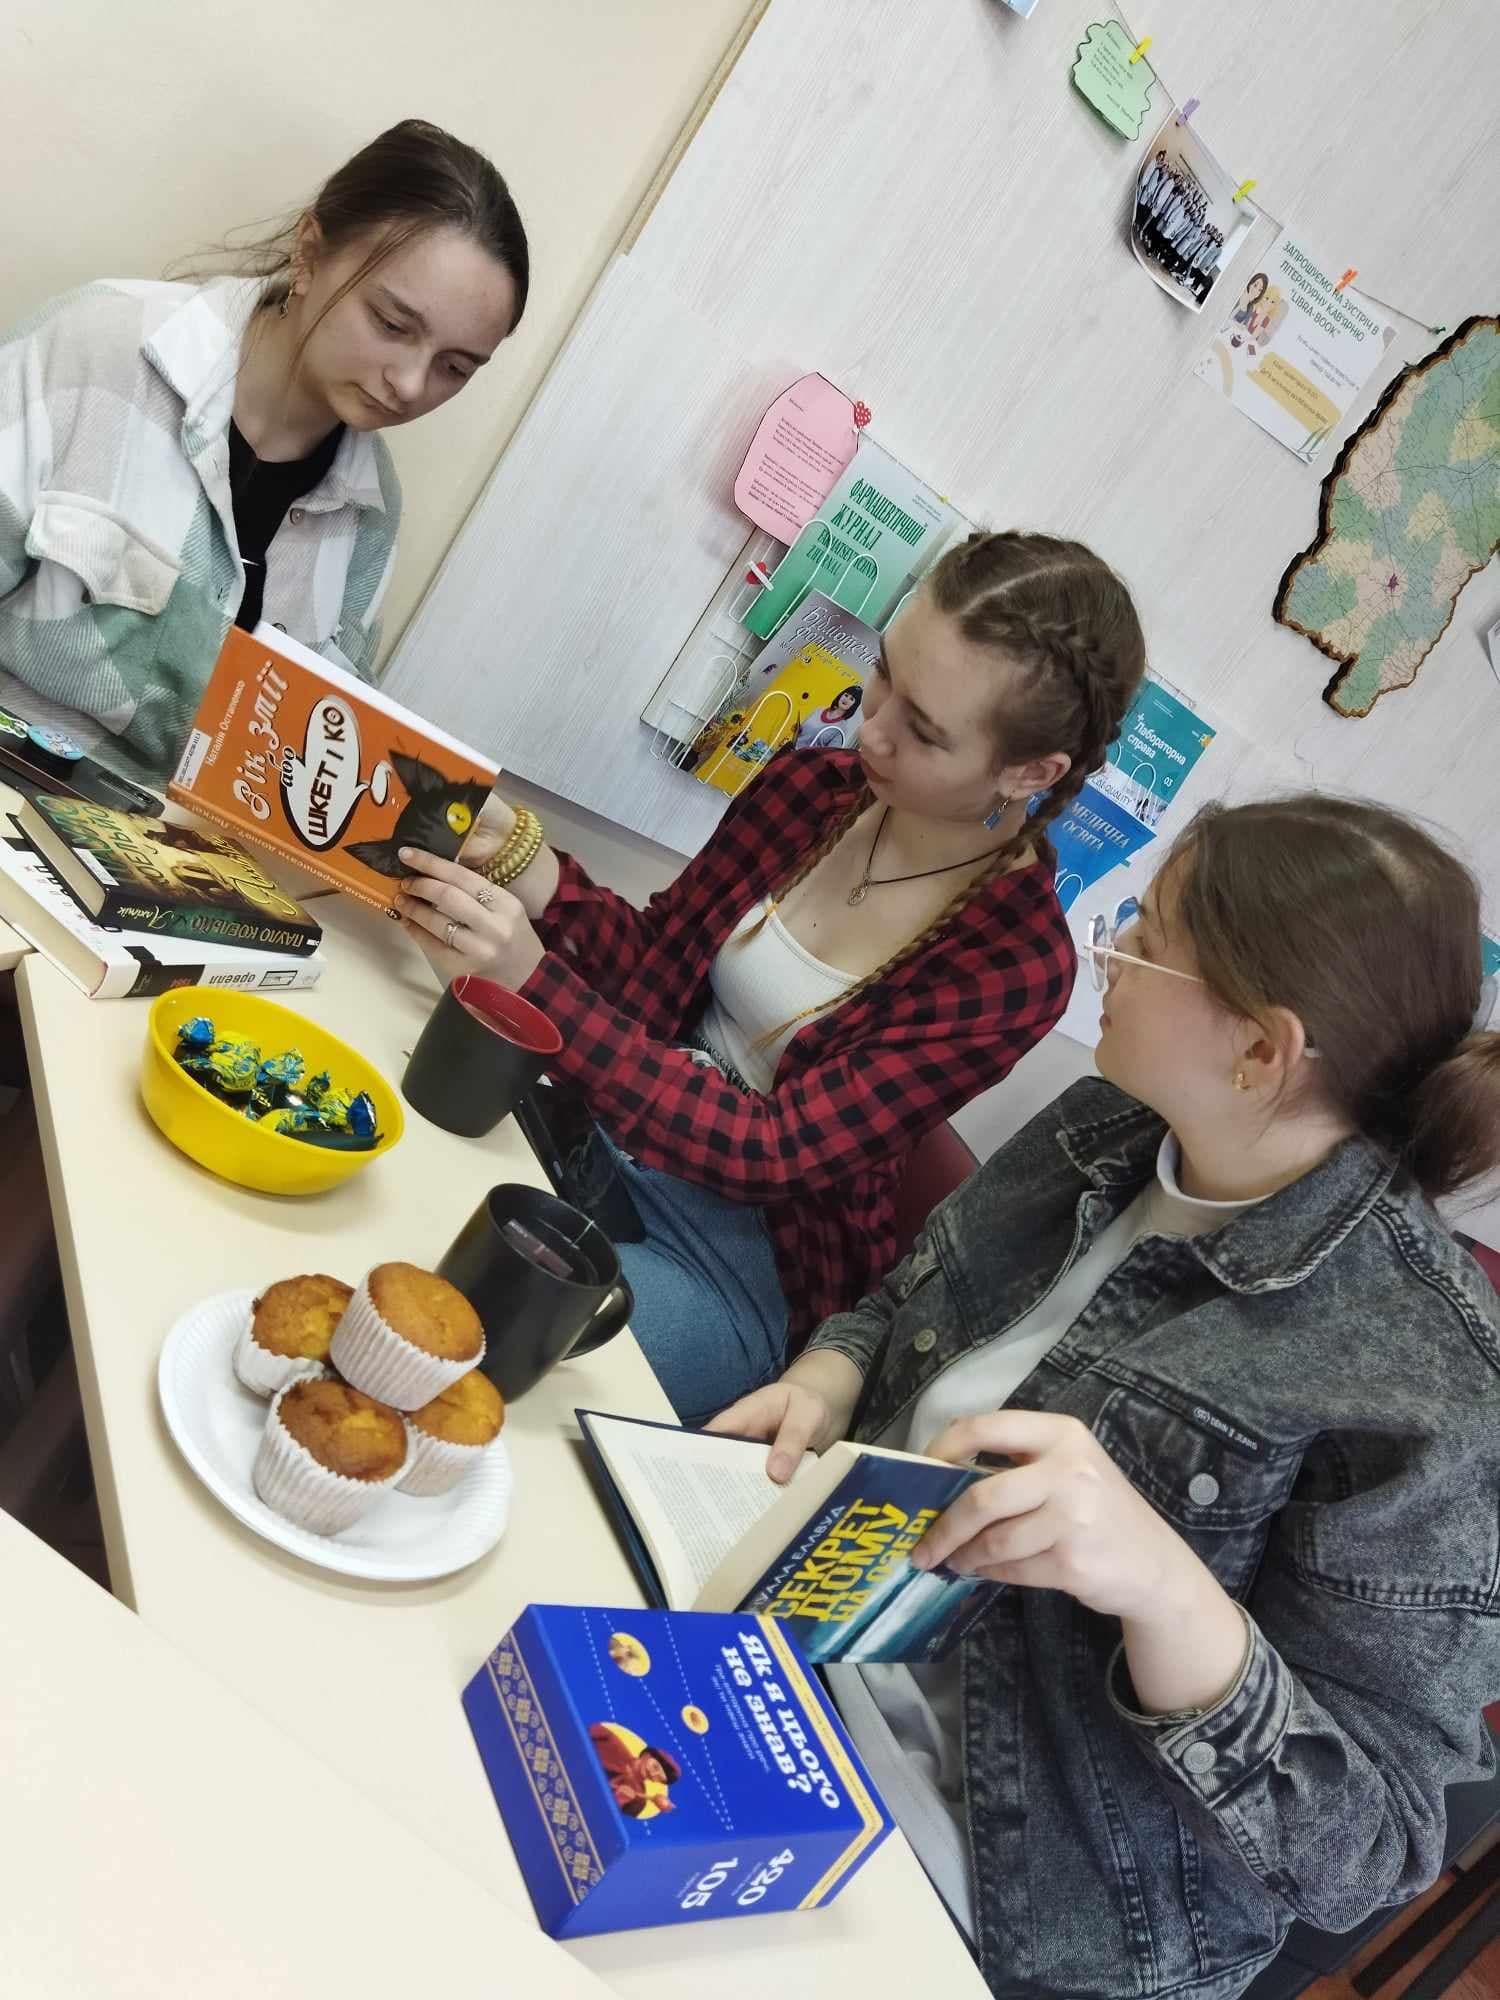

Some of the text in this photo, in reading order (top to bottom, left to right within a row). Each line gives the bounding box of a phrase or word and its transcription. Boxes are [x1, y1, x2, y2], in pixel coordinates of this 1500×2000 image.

[1280, 260, 1329, 307] ЛІТЕРАТУРНУ
[1283, 241, 1334, 294] ЗАПРОШУЄМО
[831, 503, 883, 550] ЖУРНАЛ
[1127, 734, 1156, 759] справа
[1133, 722, 1187, 766] Лабораторна
[308, 760, 338, 838] ШКЕТ
[345, 886, 383, 911] можна
[191, 919, 258, 942] КОЕЛЬЙО
[260, 930, 305, 948] ПАУЛО
[764, 1498, 881, 1619] СЕКРЕТ
[794, 1503, 909, 1622] ДОМУ
[750, 1563, 796, 1607] УАЛА
[828, 1584, 871, 1622] НА
[721, 1646, 752, 1687] не
[744, 1695, 812, 1793] знав?
[737, 1632, 773, 1677] Як
[762, 1680, 786, 1702] я
[777, 1708, 840, 1808] цього
[681, 1857, 739, 1909] 105
[737, 1848, 795, 1906] 420
